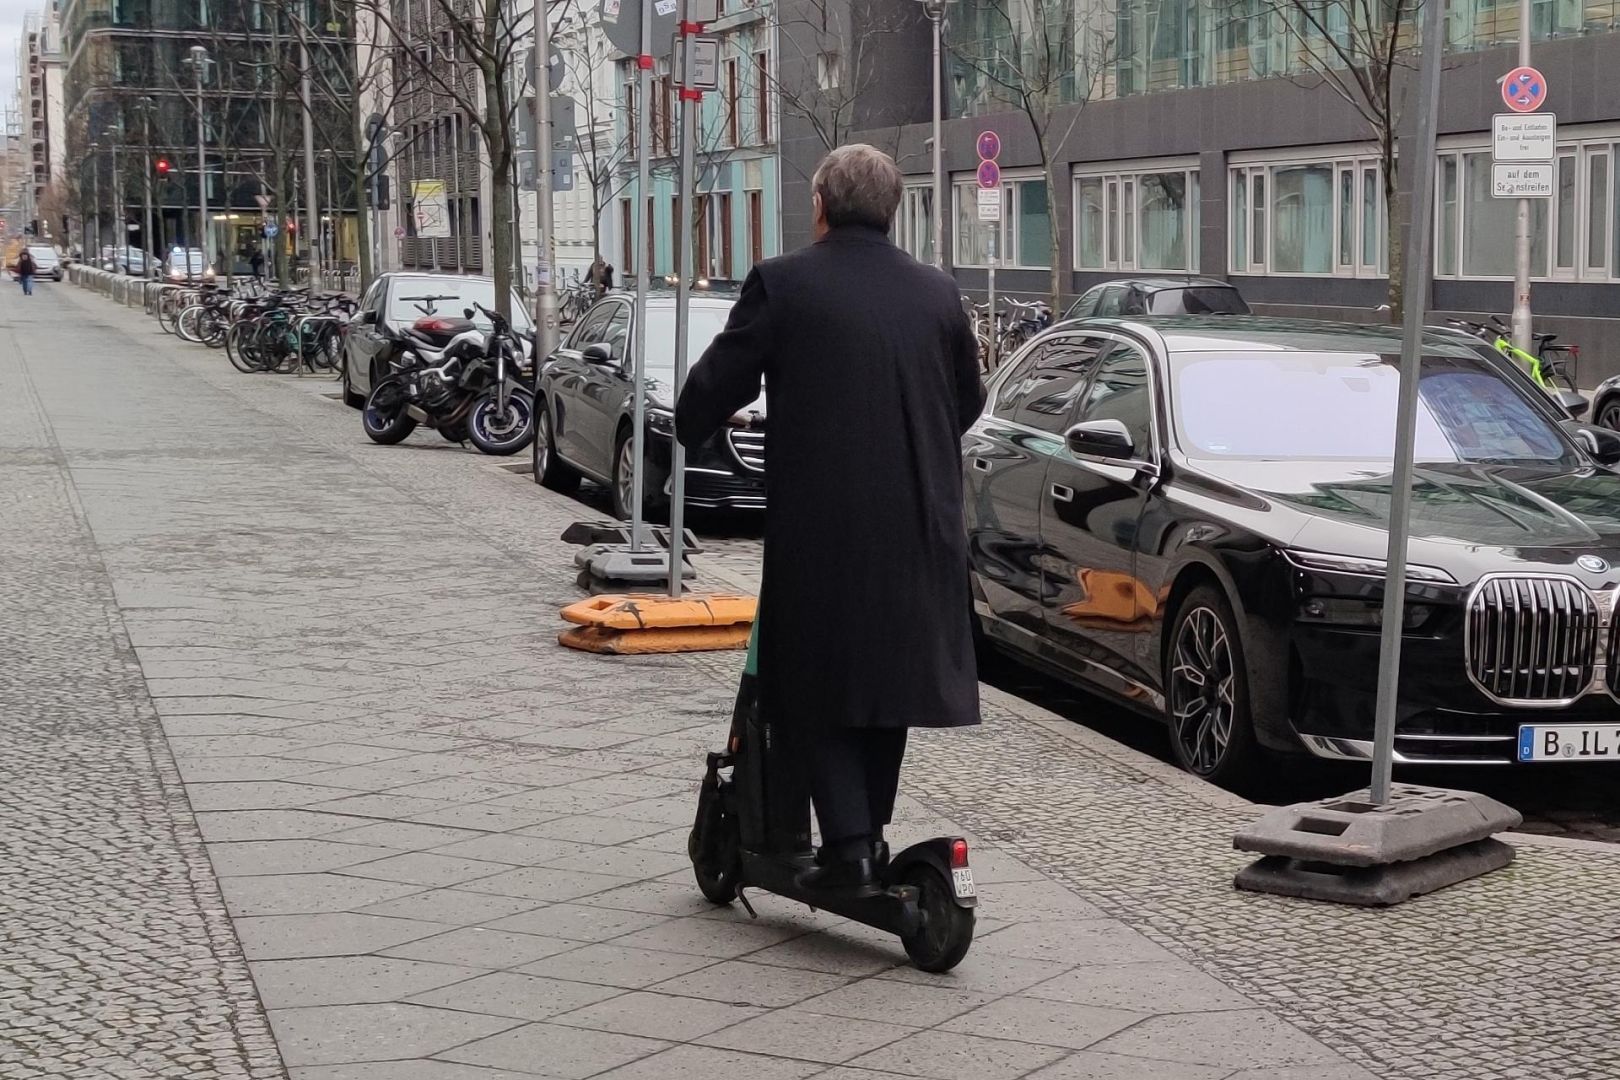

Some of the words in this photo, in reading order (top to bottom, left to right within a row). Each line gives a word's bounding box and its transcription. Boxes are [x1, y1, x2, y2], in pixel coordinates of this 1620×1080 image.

[1507, 169, 1520, 179] auf
[1523, 169, 1540, 179] dem
[1497, 182, 1550, 192] Senstreifen
[1523, 746, 1530, 755] D
[1544, 730, 1560, 756] B
[954, 869, 972, 882] 960
